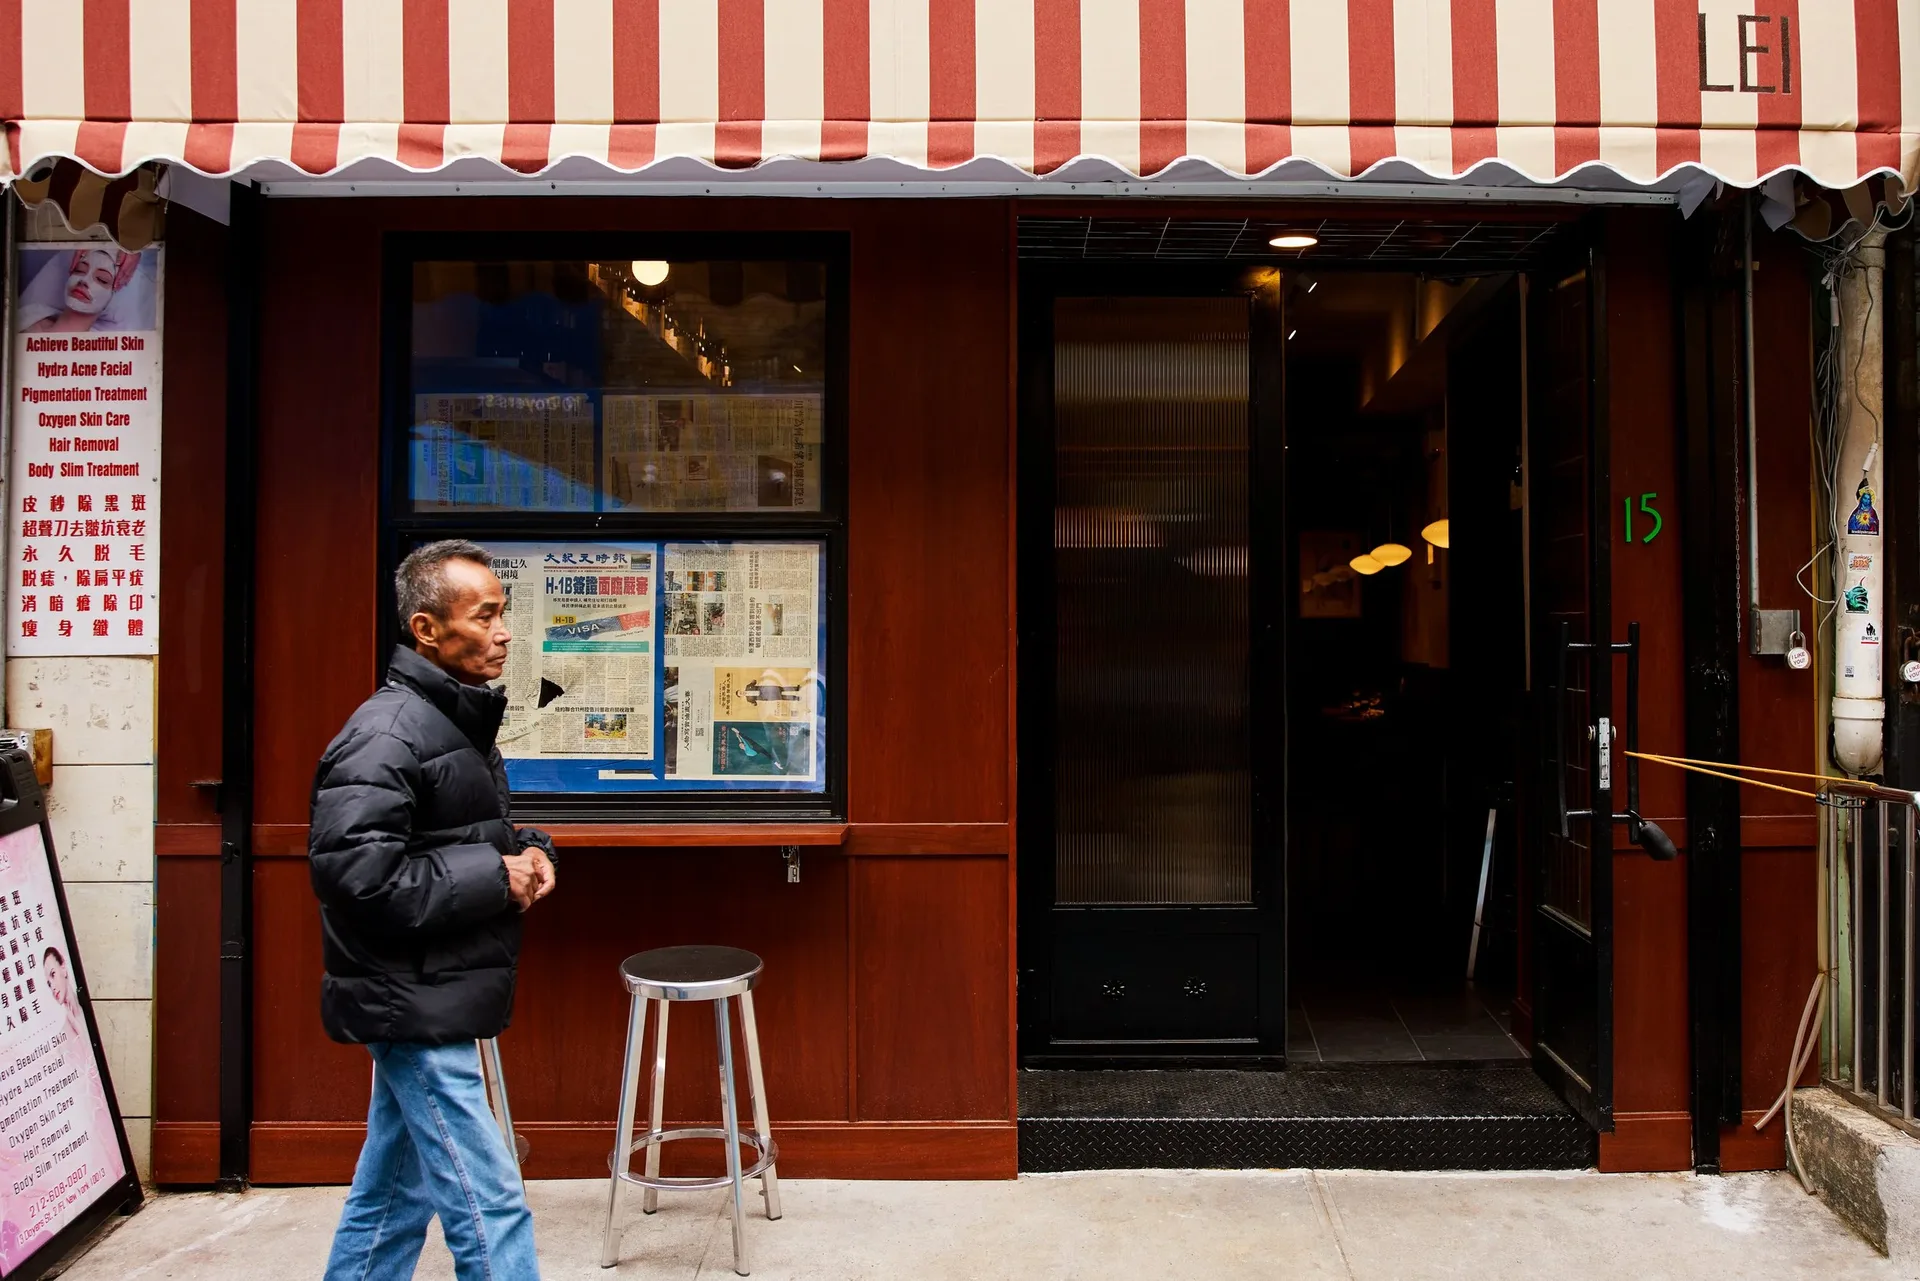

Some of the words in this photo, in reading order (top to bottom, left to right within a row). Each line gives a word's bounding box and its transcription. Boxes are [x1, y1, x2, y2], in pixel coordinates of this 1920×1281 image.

[1697, 12, 1792, 95] LEI
[26, 337, 68, 352] Achieve
[71, 336, 118, 351] Beautiful
[121, 335, 144, 350] Skin
[37, 362, 67, 378] Hydra
[71, 362, 97, 376] Acne
[100, 361, 132, 376] Facial
[22, 387, 91, 403] Pigmentation
[95, 386, 147, 401] Treatment
[39, 412, 76, 428] Oxygen
[80, 411, 102, 426] Skin
[106, 411, 130, 426] Care
[49, 438, 71, 452] Hair
[74, 437, 119, 451] Removal
[28, 462, 54, 478] Body
[60, 462, 84, 477] Slim
[87, 462, 139, 476] Treatment
[1624, 492, 1663, 543] 15
[544, 553, 628, 565] 大紀元時報
[567, 623, 600, 635] VISA
[1795, 651, 1805, 659] LIKE
[16, 1041, 51, 1071] Beautiful
[51, 1032, 67, 1048] Skin
[23, 1072, 42, 1089] Acne
[43, 1054, 65, 1077] Facial
[43, 1068, 79, 1100] Treatment
[9, 1122, 39, 1149] Oxygen
[39, 1109, 56, 1127] Skin
[56, 1096, 74, 1115] Care
[23, 1144, 40, 1163] Hair
[41, 1119, 72, 1150] Removal
[13, 1173, 34, 1195] Body
[35, 1160, 52, 1178] Slim
[52, 1130, 89, 1164] Treatment
[29, 1163, 87, 1218] 212-608-0907
[24, 1219, 45, 1241] Doyers
